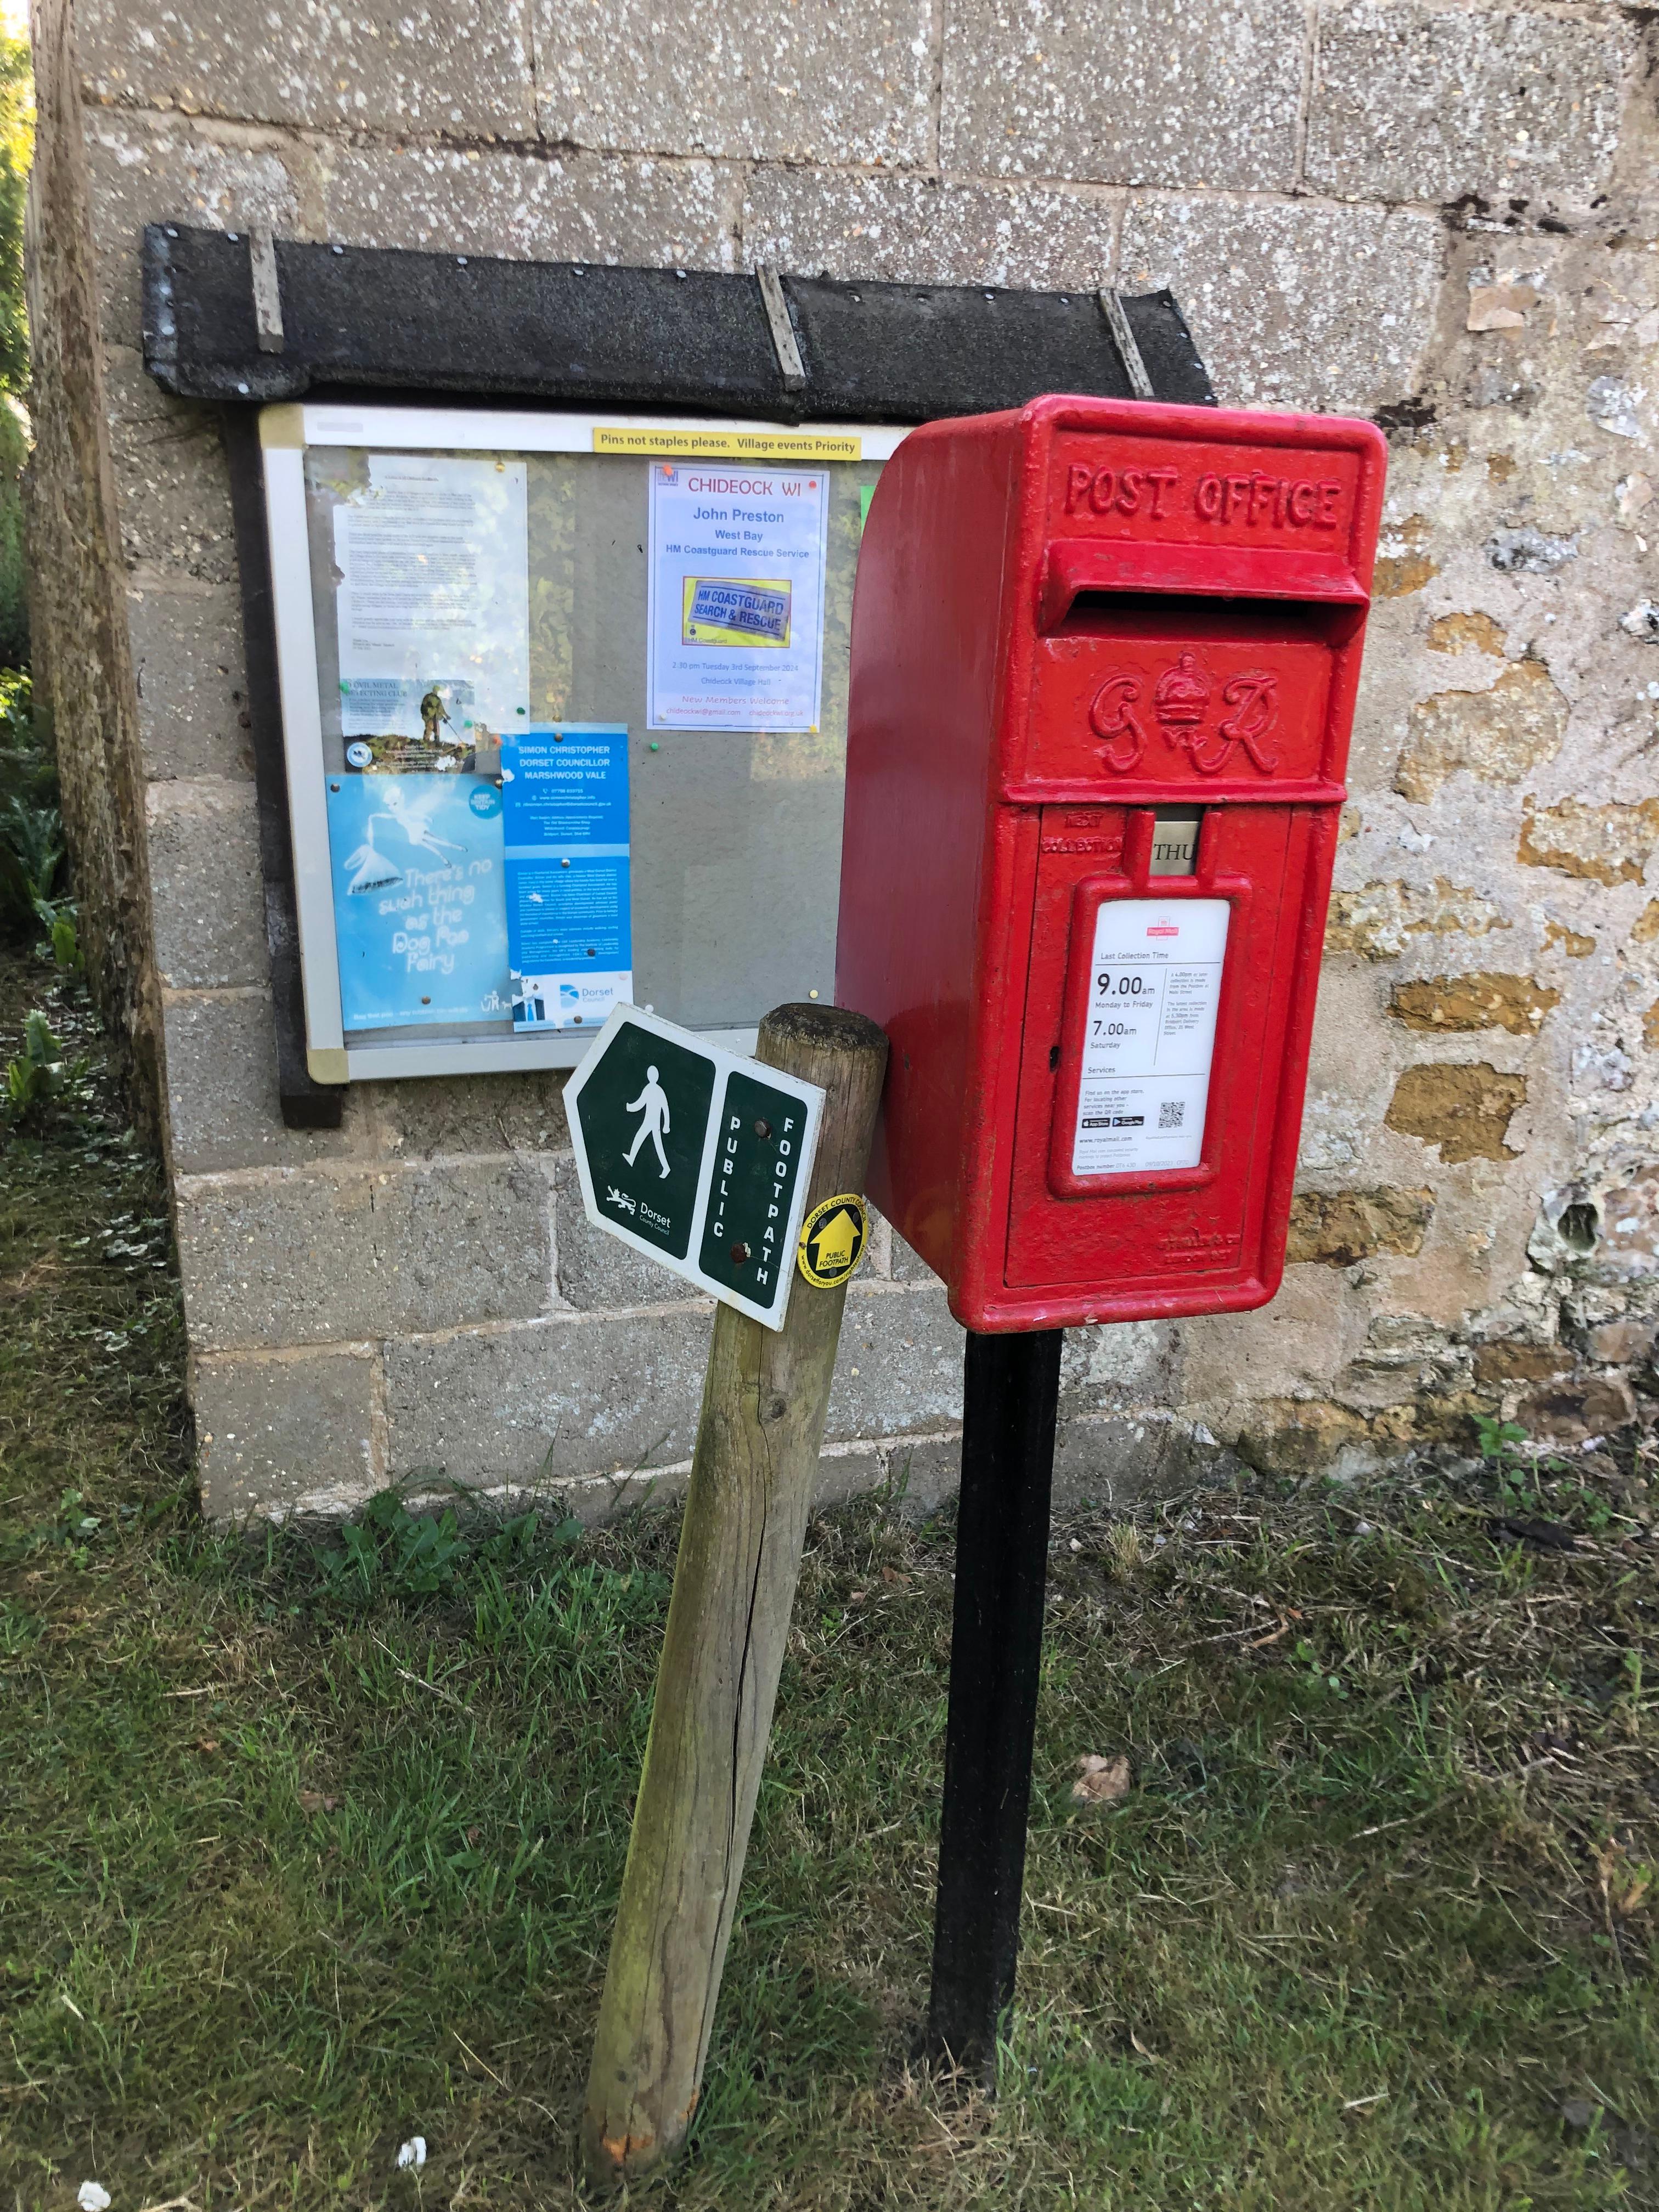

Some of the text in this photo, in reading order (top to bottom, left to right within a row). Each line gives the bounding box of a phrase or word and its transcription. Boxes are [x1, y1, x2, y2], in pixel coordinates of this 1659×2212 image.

[601, 435, 855, 454] Pins not staples please. Village events Priority
[689, 477, 800, 496] CHIDEOCK WI
[1065, 463, 1343, 531] POST OFFICE
[693, 507, 784, 522] John Preston
[715, 530, 763, 543] West Bay
[666, 545, 809, 558] HM Coastguard Rescue Service
[698, 590, 783, 616] HM COASTGUARD
[695, 604, 781, 631] SEARCH & RESCUE
[734, 678, 756, 686] Village
[518, 746, 610, 754] SIMON CHRISTOPHER
[556, 759, 610, 767] COUNCILLOR
[1154, 843, 1196, 860] THU
[405, 859, 492, 888] There's no
[379, 884, 475, 916] such thing
[405, 906, 462, 930] as the
[393, 926, 469, 956] Dog Poo
[407, 952, 455, 975] Fairy
[582, 988, 613, 996] Dorset
[1098, 973, 1155, 995] 9.00am
[1132, 1001, 1153, 1009] Friday
[1093, 1020, 1137, 1036] 7.00am
[714, 1116, 741, 1238] PUBLIC
[756, 1117, 794, 1285] FOOTPATH
[641, 1202, 671, 1228] Dorset
[807, 1197, 867, 1229] DORSET COUNTY COUNCIL
[819, 1257, 849, 1267] FOOTPATH
[826, 1250, 845, 1259] PUBLIC
